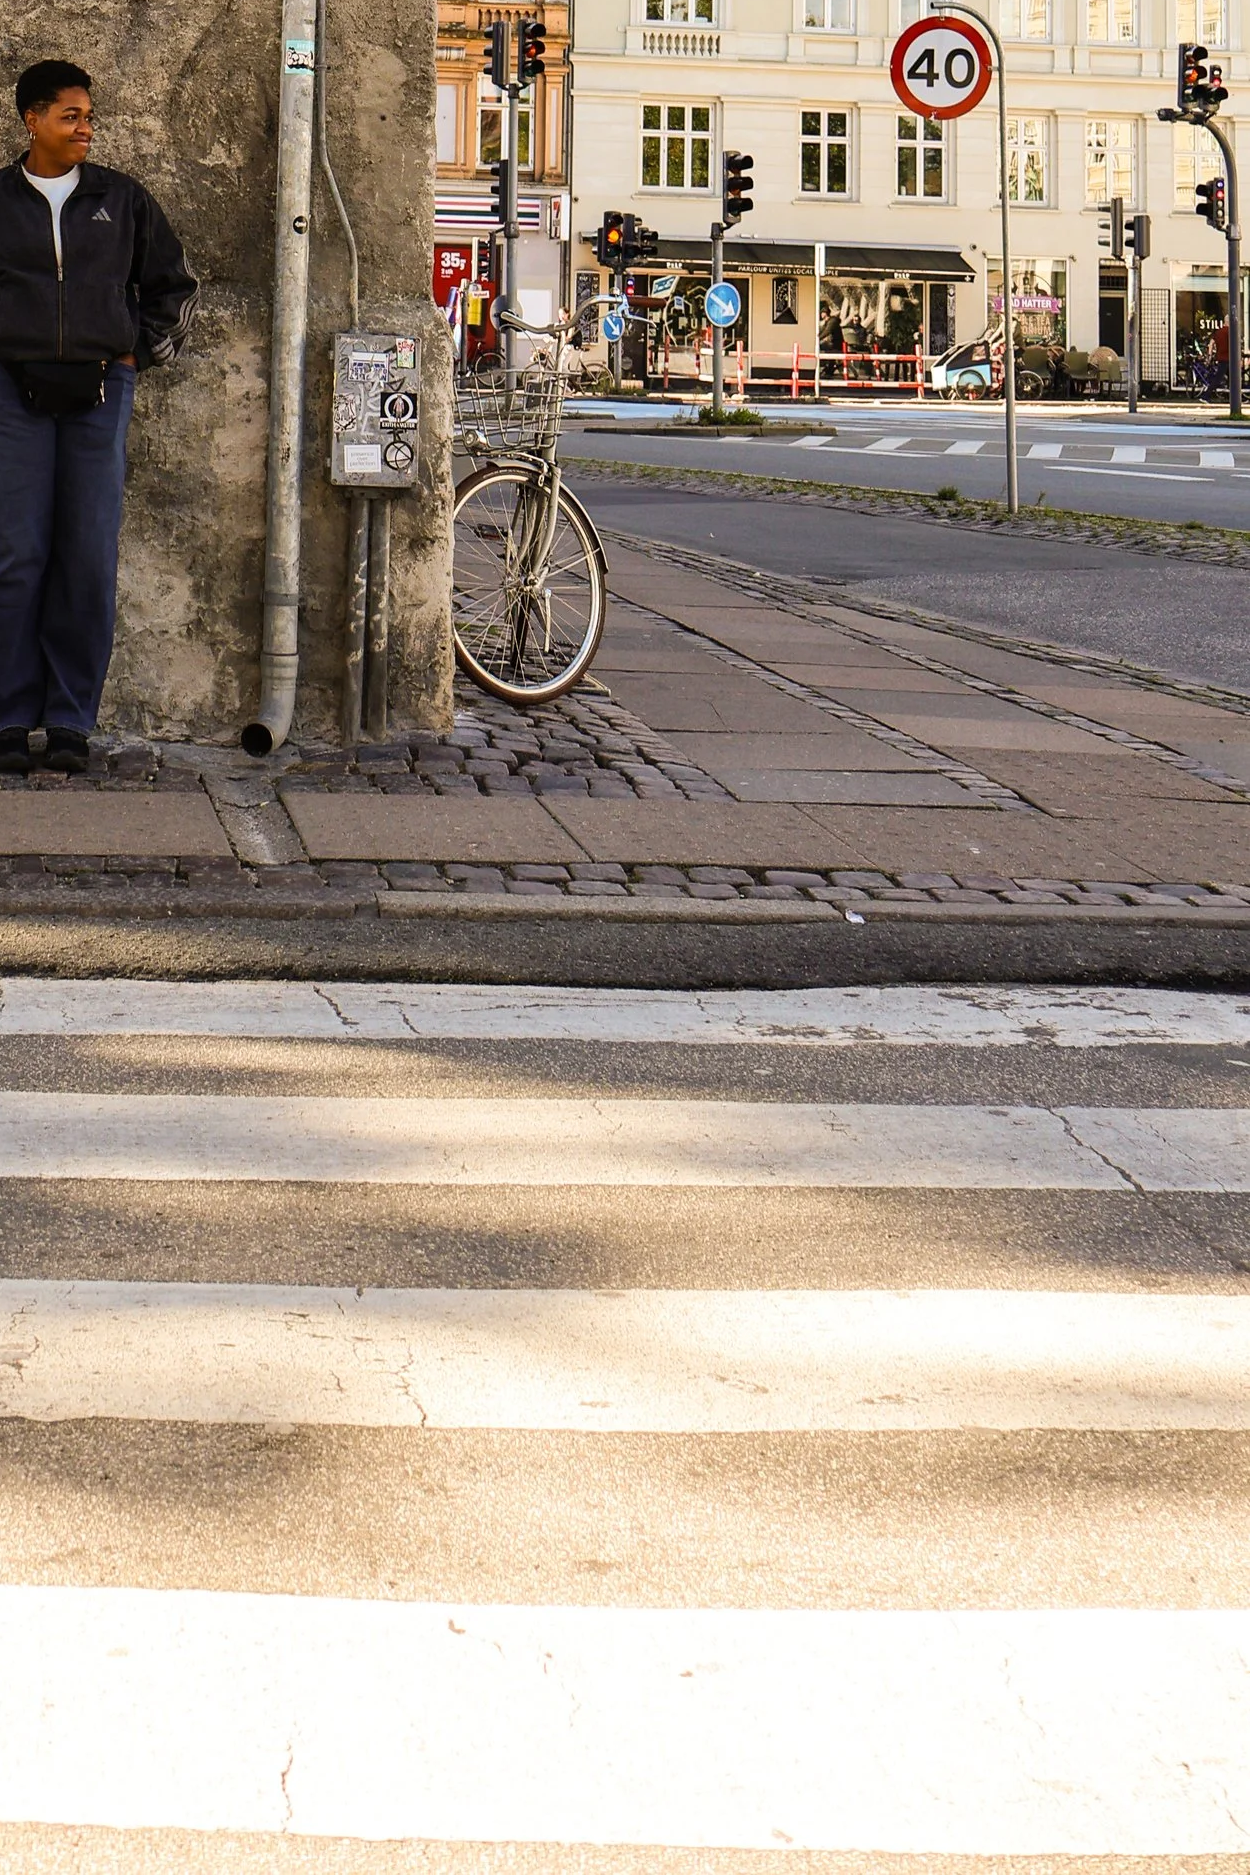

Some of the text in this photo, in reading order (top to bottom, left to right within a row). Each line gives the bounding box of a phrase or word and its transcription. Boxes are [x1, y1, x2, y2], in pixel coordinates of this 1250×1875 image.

[907, 48, 975, 89] 40
[1001, 298, 1052, 309] AD HATTER
